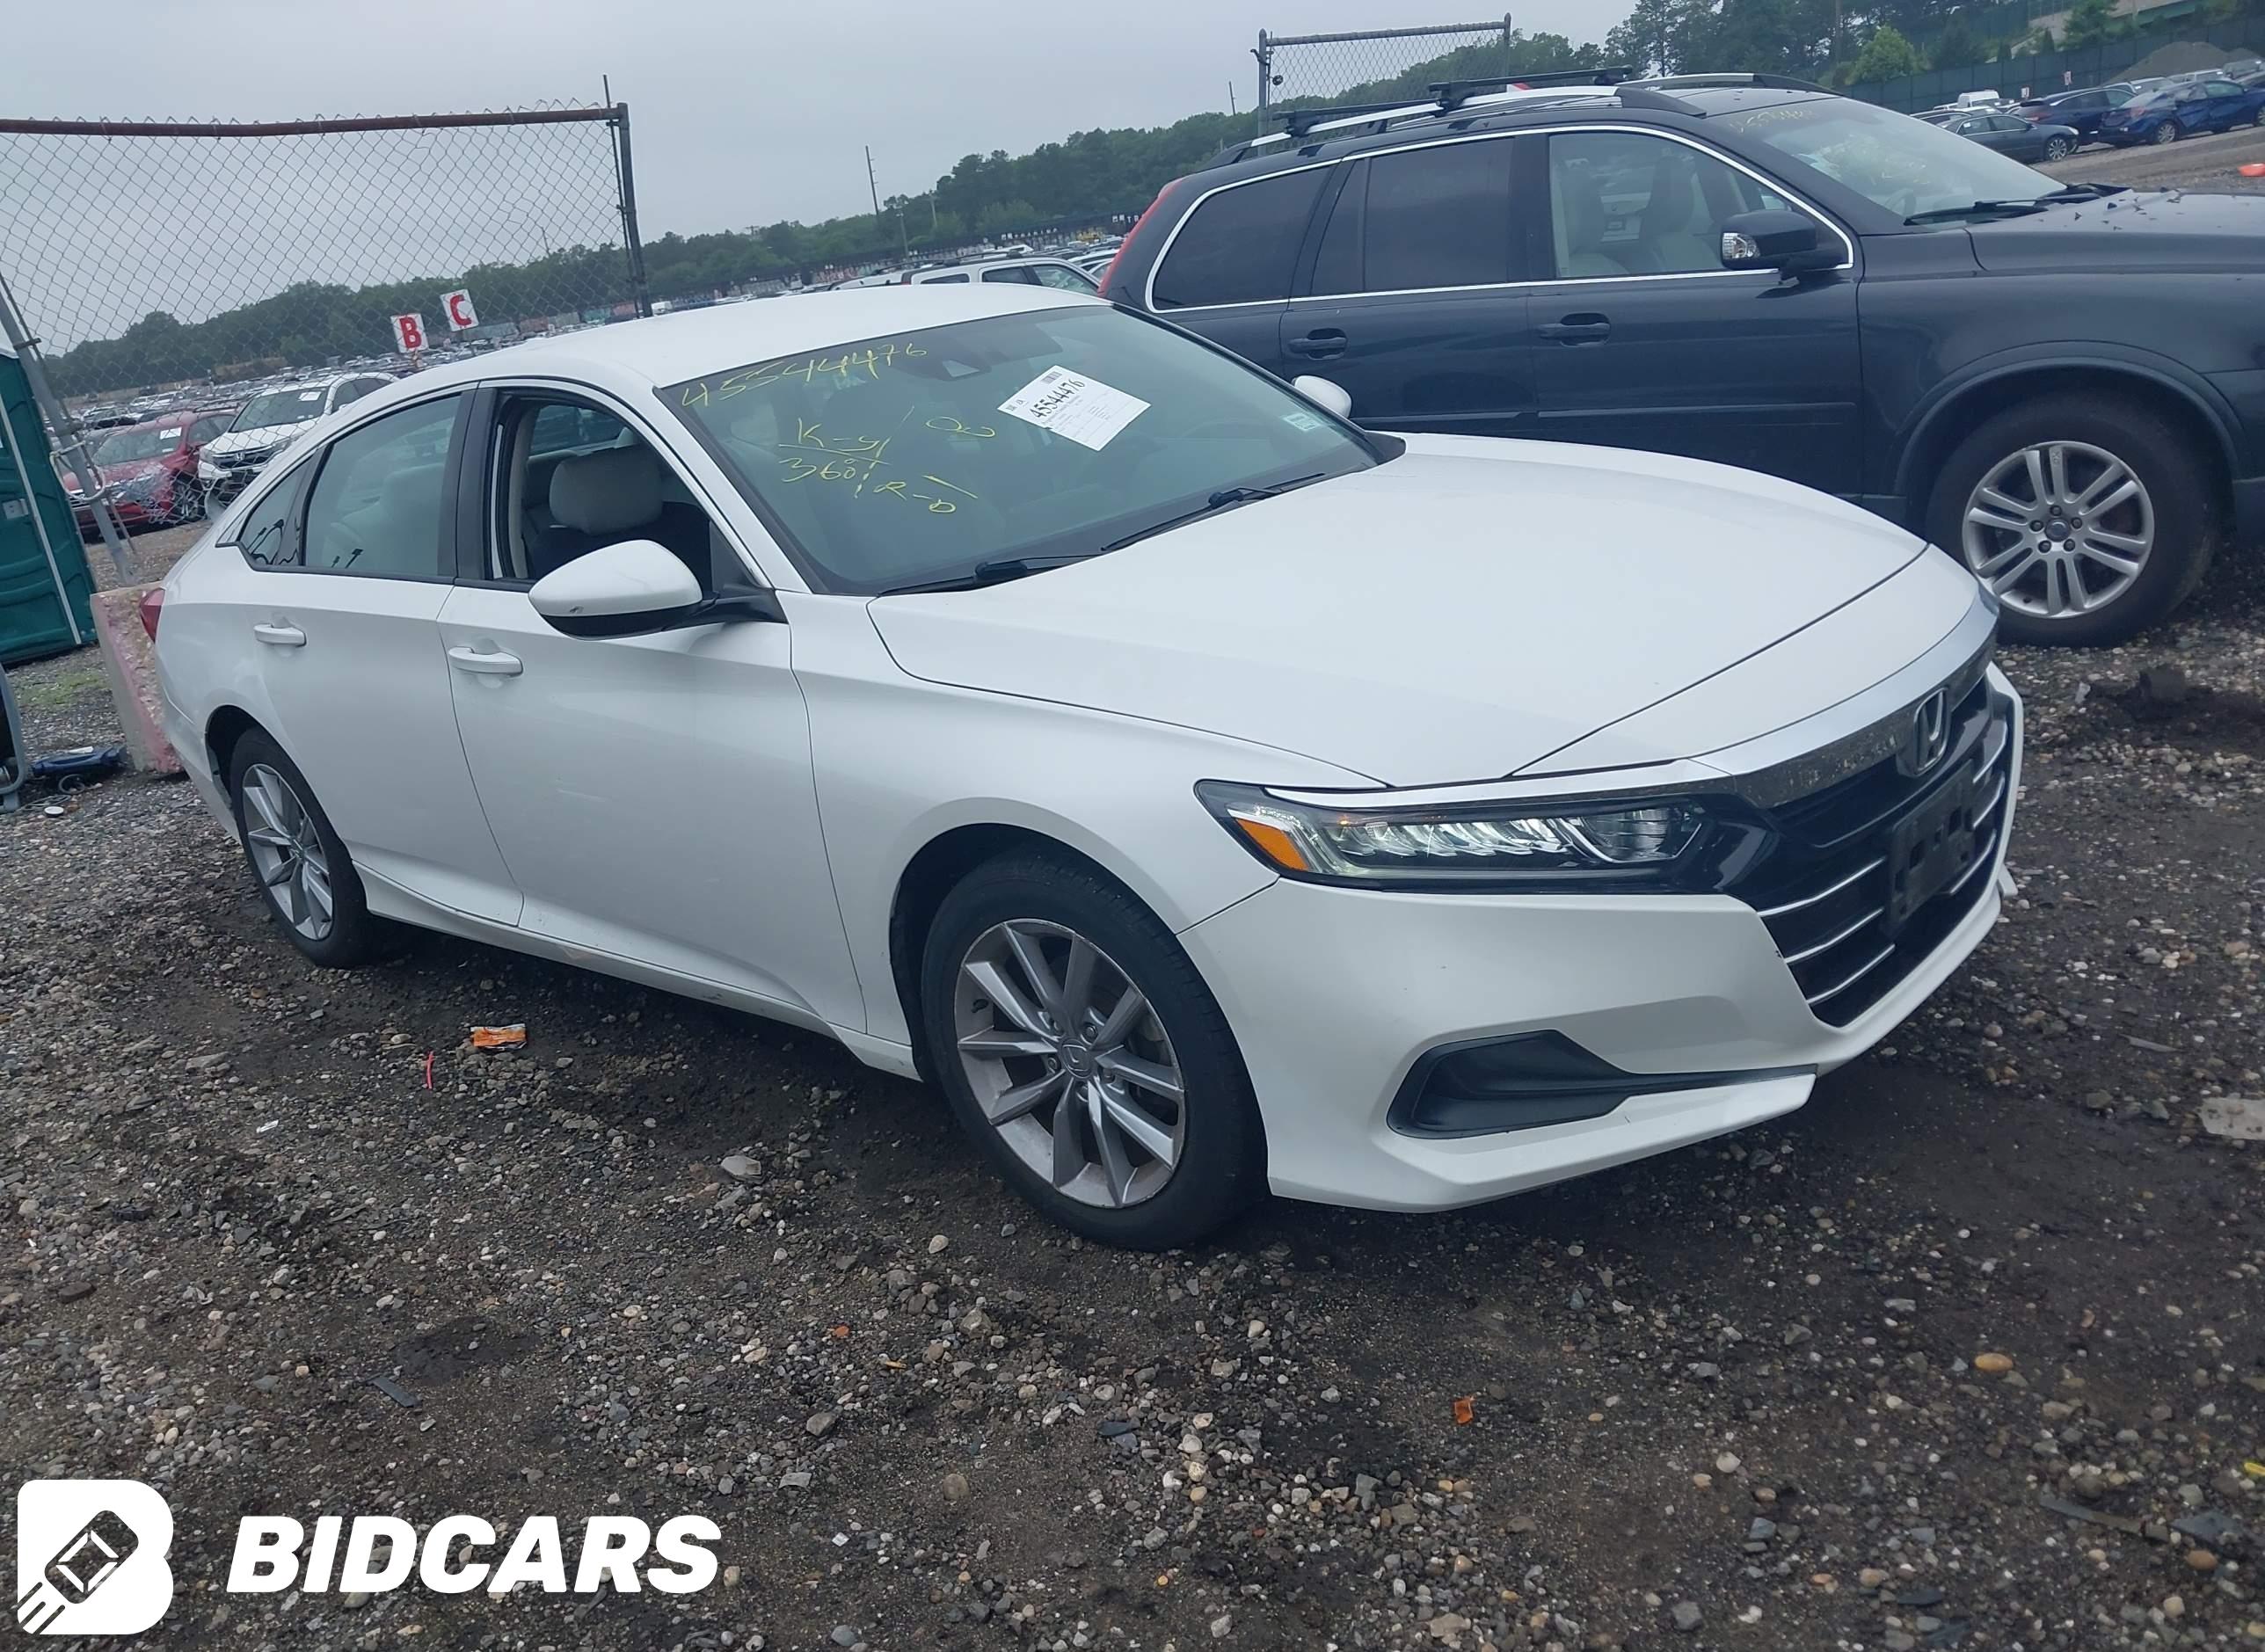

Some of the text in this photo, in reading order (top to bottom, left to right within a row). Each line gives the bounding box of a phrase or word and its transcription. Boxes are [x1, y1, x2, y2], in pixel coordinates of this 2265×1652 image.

[450, 295, 472, 326] C
[399, 317, 422, 348] B
[1030, 378, 1085, 418] 45544476
